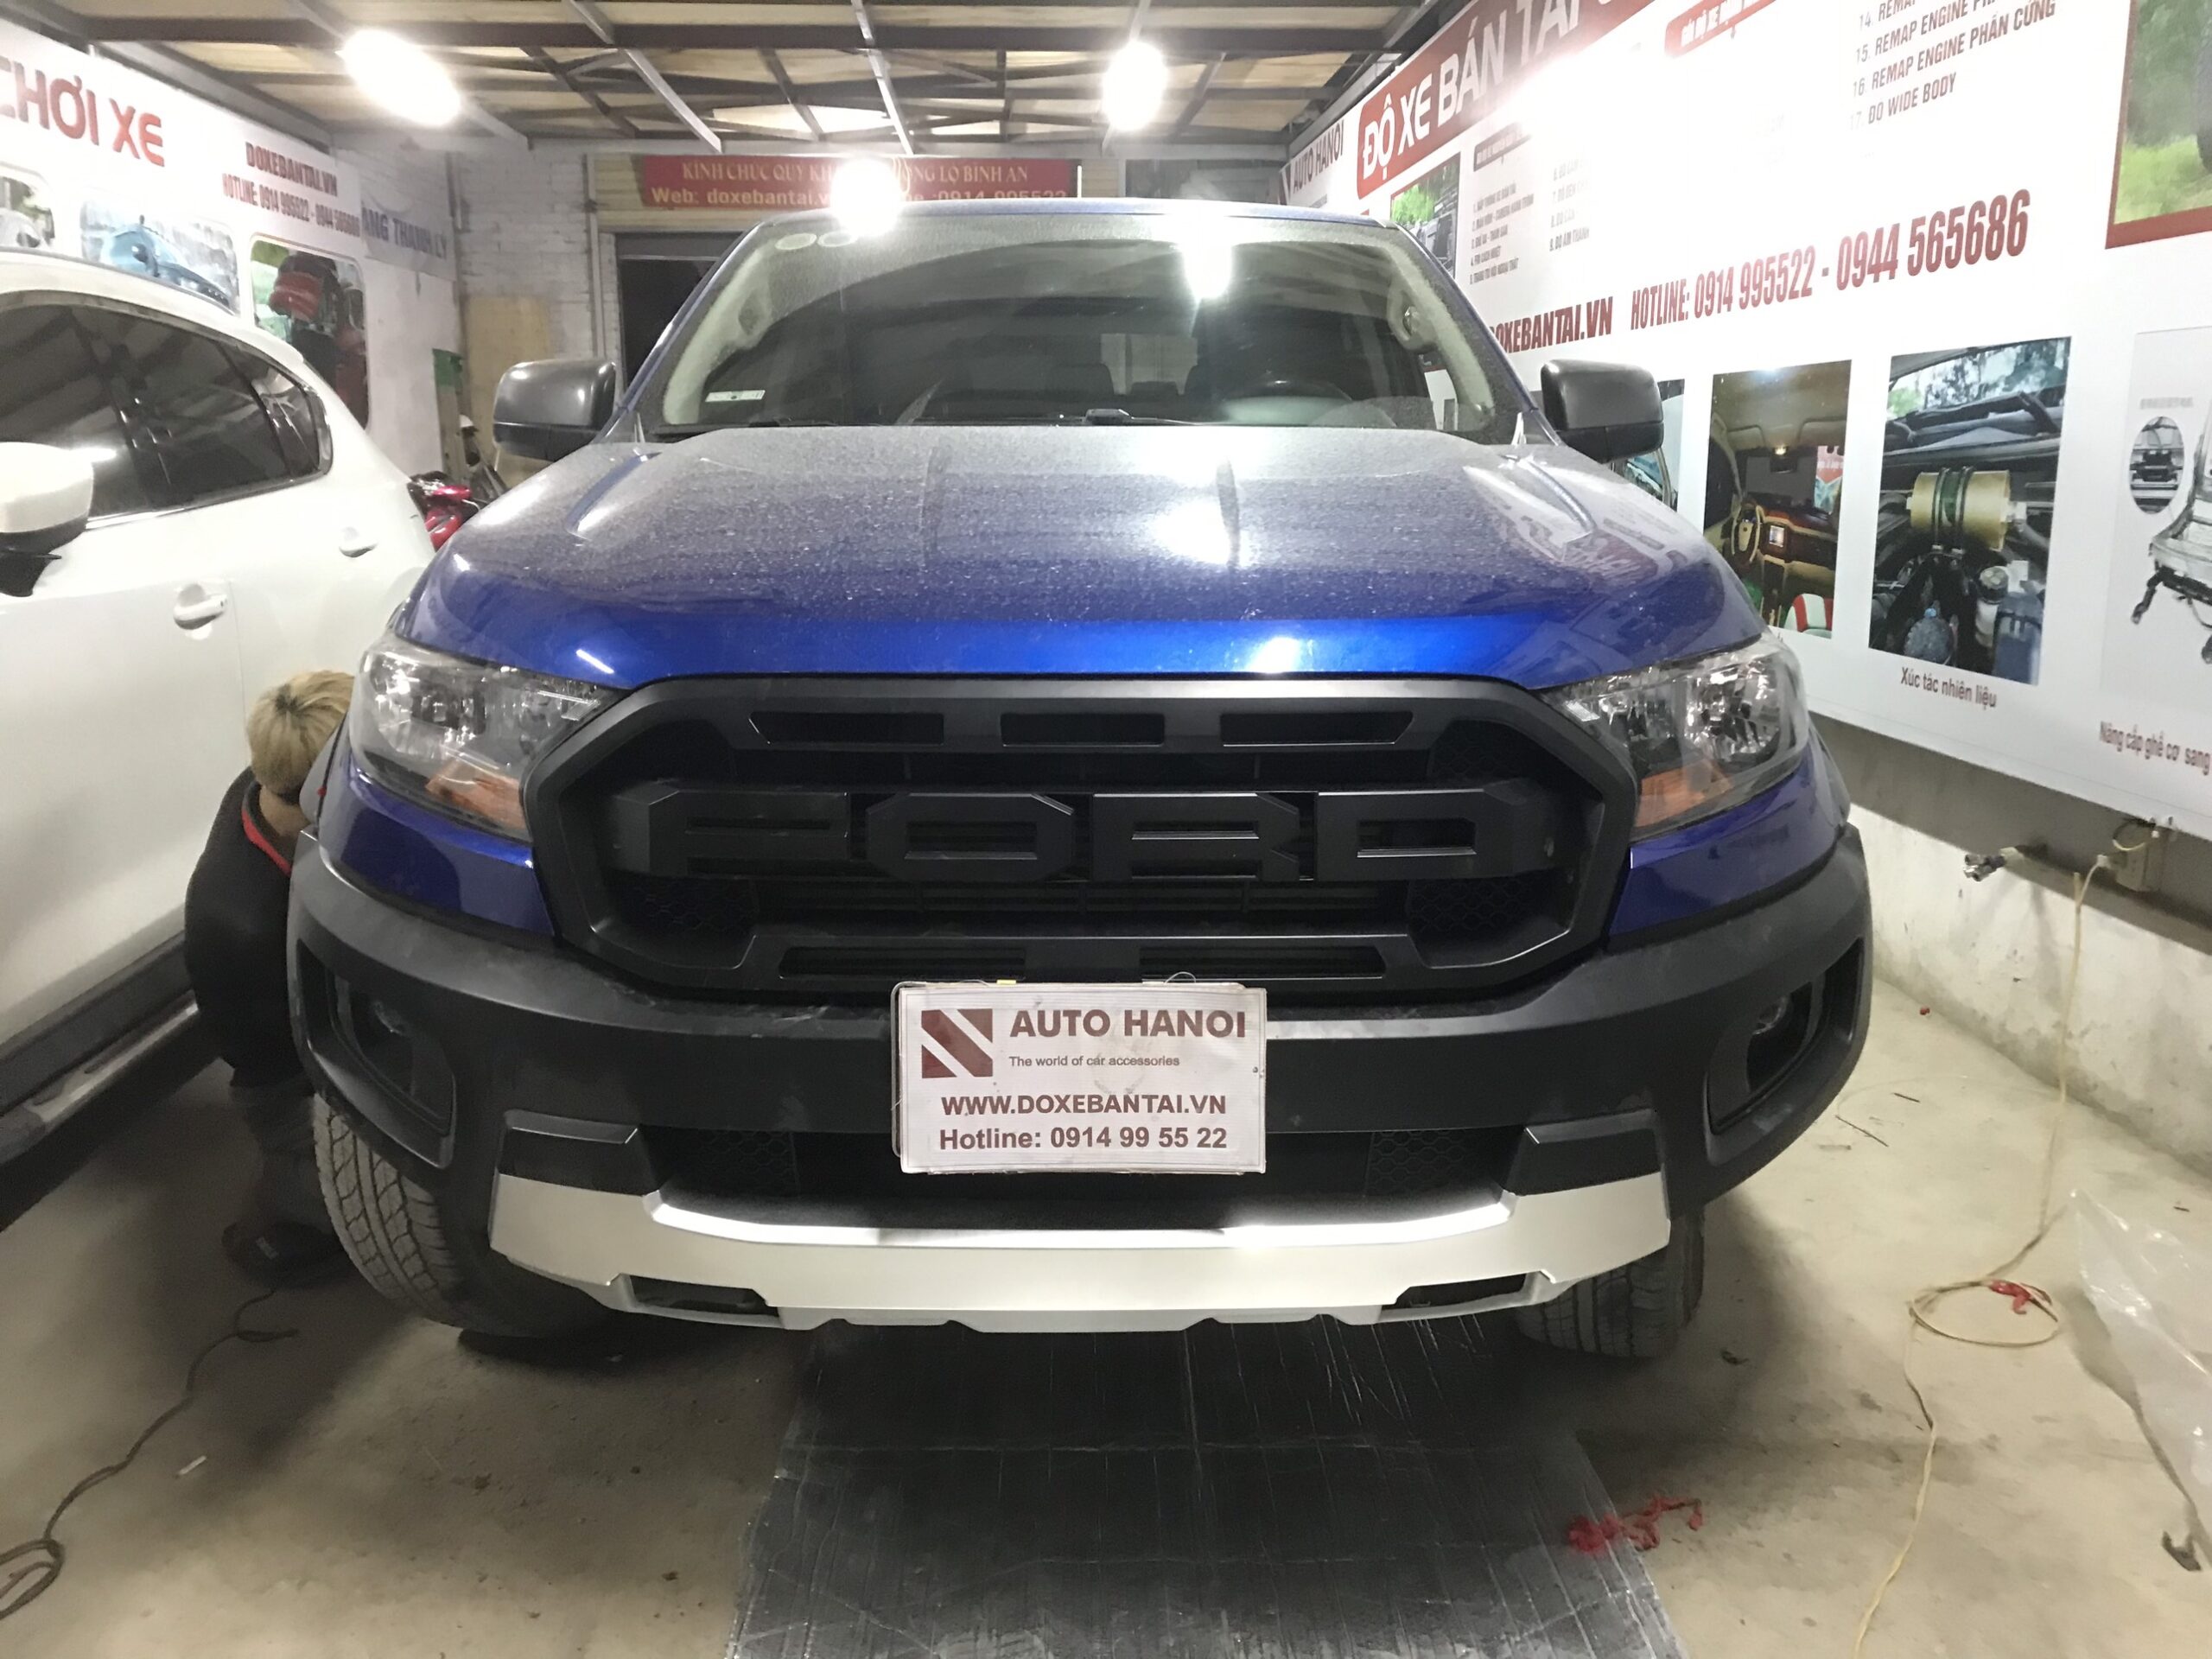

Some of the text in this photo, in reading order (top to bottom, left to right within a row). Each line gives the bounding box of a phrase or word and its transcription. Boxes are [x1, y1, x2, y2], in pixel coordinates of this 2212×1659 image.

[1875, 20, 1917, 56] REMAP
[1921, 0, 1968, 35] ENGINE
[1872, 55, 1914, 91] REMAP
[1917, 32, 1967, 72] ENGINE
[1363, 93, 1395, 181] ĐỘ
[1397, 73, 1433, 156] XE
[1437, 10, 1507, 128] BÁN
[1888, 86, 1919, 117] WIDE
[1923, 71, 1956, 104] BODY
[109, 98, 165, 167] XE
[1005, 165, 1028, 182] AN
[1294, 119, 1344, 194] AUTO HANOI
[652, 188, 699, 205] Web:
[707, 188, 832, 207] doxebantai.v
[1490, 296, 1613, 353] OXEBANTAI.VN
[1630, 279, 1689, 331] HOTLINE:
[1694, 266, 1734, 319] 0914
[1738, 245, 1815, 310] 995522
[1836, 222, 1900, 291] 0944
[1907, 188, 2031, 276] 565686
[1901, 667, 1997, 710] Xúc tác nhiên liệu
[612, 783, 1547, 881] FORD
[1009, 1009, 1246, 1038] AUTO HANOI
[1009, 1055, 1180, 1067] The world of car accessories
[941, 1094, 1227, 1116] WWW.DOXEBANTAI.VN
[939, 1126, 1228, 1150] Hotline: 0914 99 55 22
